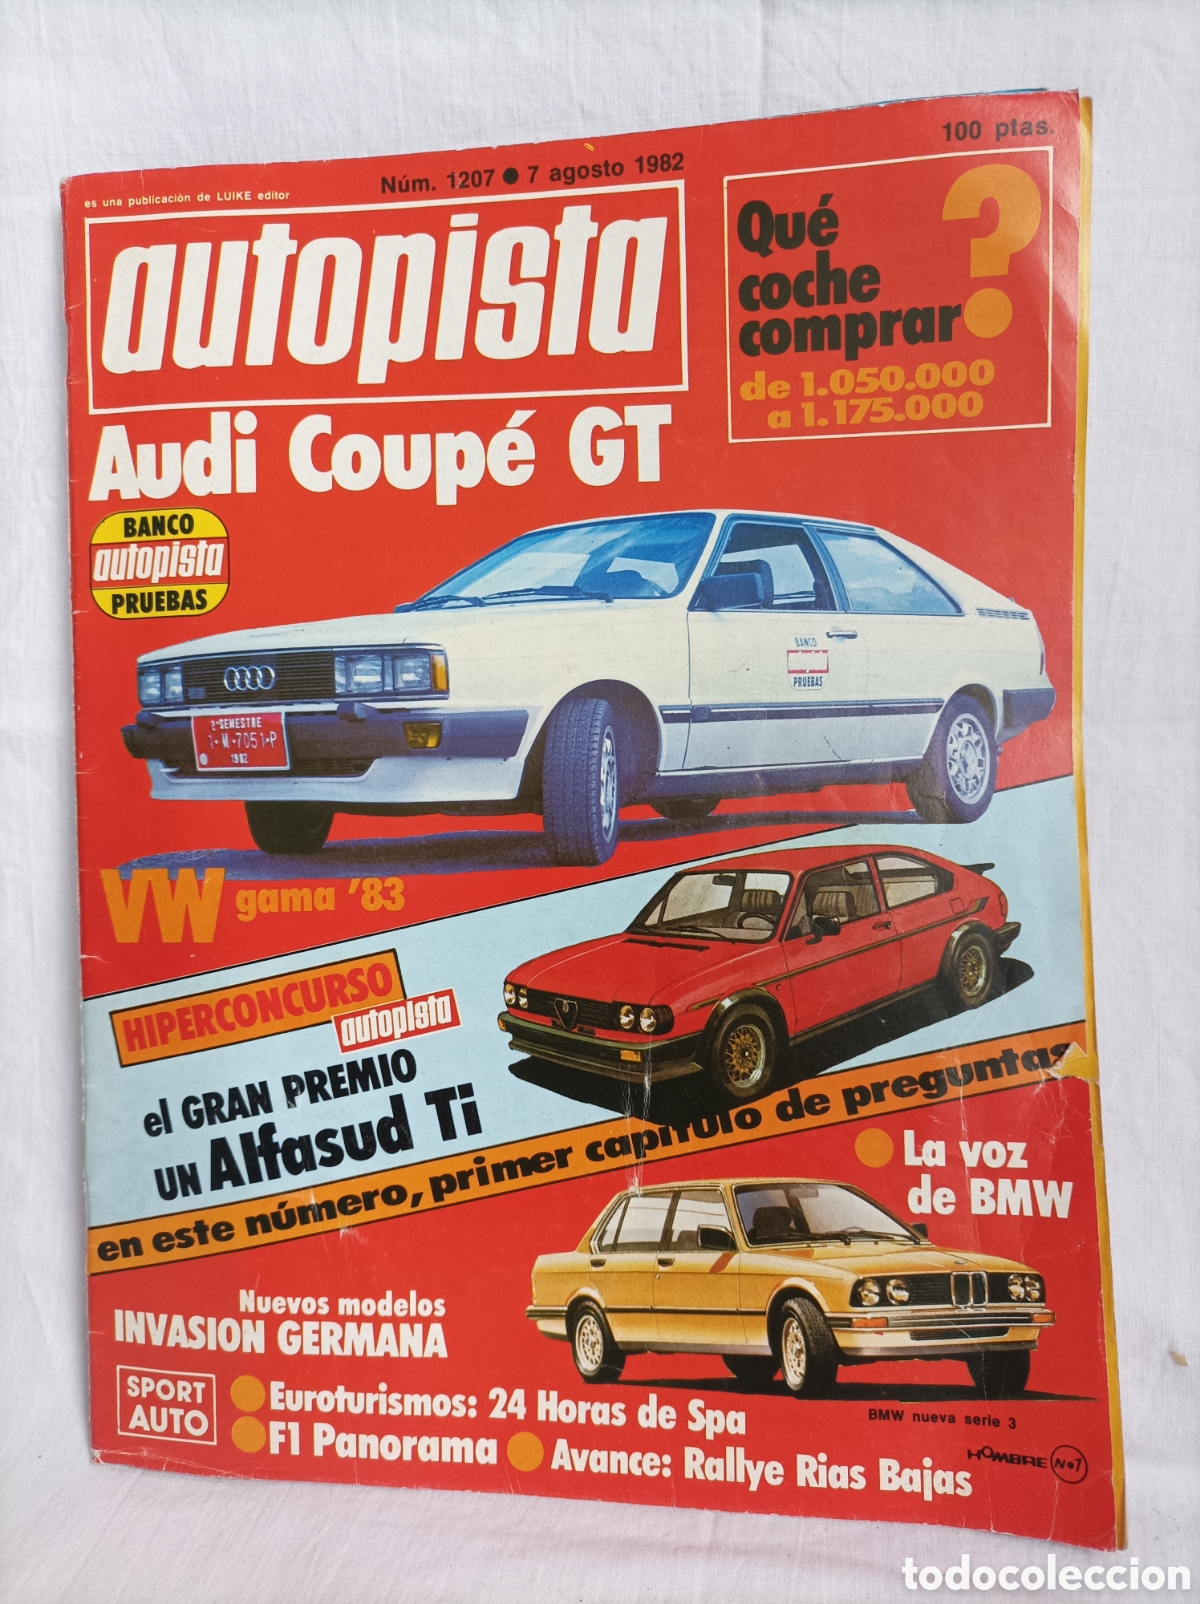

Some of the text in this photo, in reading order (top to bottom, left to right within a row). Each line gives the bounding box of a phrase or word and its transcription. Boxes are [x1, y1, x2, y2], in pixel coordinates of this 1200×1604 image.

[942, 117, 1055, 143] 100 ptas.
[380, 152, 685, 195] Núm. 1207 7 agosto 1982
[84, 191, 290, 208] es una publicación de LUIKE editor
[736, 193, 839, 258] Qué
[100, 204, 668, 384] autopista
[738, 249, 881, 312] coche
[738, 303, 961, 362] comprar
[739, 359, 995, 402] de 1.050.000
[767, 391, 984, 429] a 1.175.000
[88, 404, 672, 506] Audi Coupé GT
[123, 513, 195, 538] BANCO
[92, 540, 225, 584] autopista
[111, 588, 208, 615] PRUEBAS
[793, 676, 823, 688] PRUEBAS
[101, 868, 226, 944] VW
[235, 884, 336, 921] gama
[122, 962, 393, 1053] HIPERCONCURSO
[341, 995, 452, 1047] autopista
[144, 1048, 417, 1137] el GRAN PREMIO
[154, 1082, 483, 1202] UN Alfasud Ti
[904, 1129, 1028, 1169] La voz
[97, 1235, 144, 1262] en
[152, 1218, 235, 1253] este
[247, 1182, 424, 1236] número,
[429, 1142, 573, 1202] primer
[776, 1087, 831, 1123] de
[907, 1174, 1073, 1219] de BMW
[239, 1289, 446, 1317] Nuevos modelos
[114, 1308, 448, 1359] INVASION GERMANA
[126, 1375, 206, 1404] SPORT
[270, 1380, 746, 1440] Euroturismos: 24 Horas de Spa
[128, 1404, 209, 1438] AUTO
[868, 1408, 1018, 1430] BMW nueva serie 3
[269, 1421, 498, 1465] F1 Panorama
[967, 1445, 1048, 1469] HOMBRE
[551, 1437, 973, 1501] Avance: Rallye Rias Bajas
